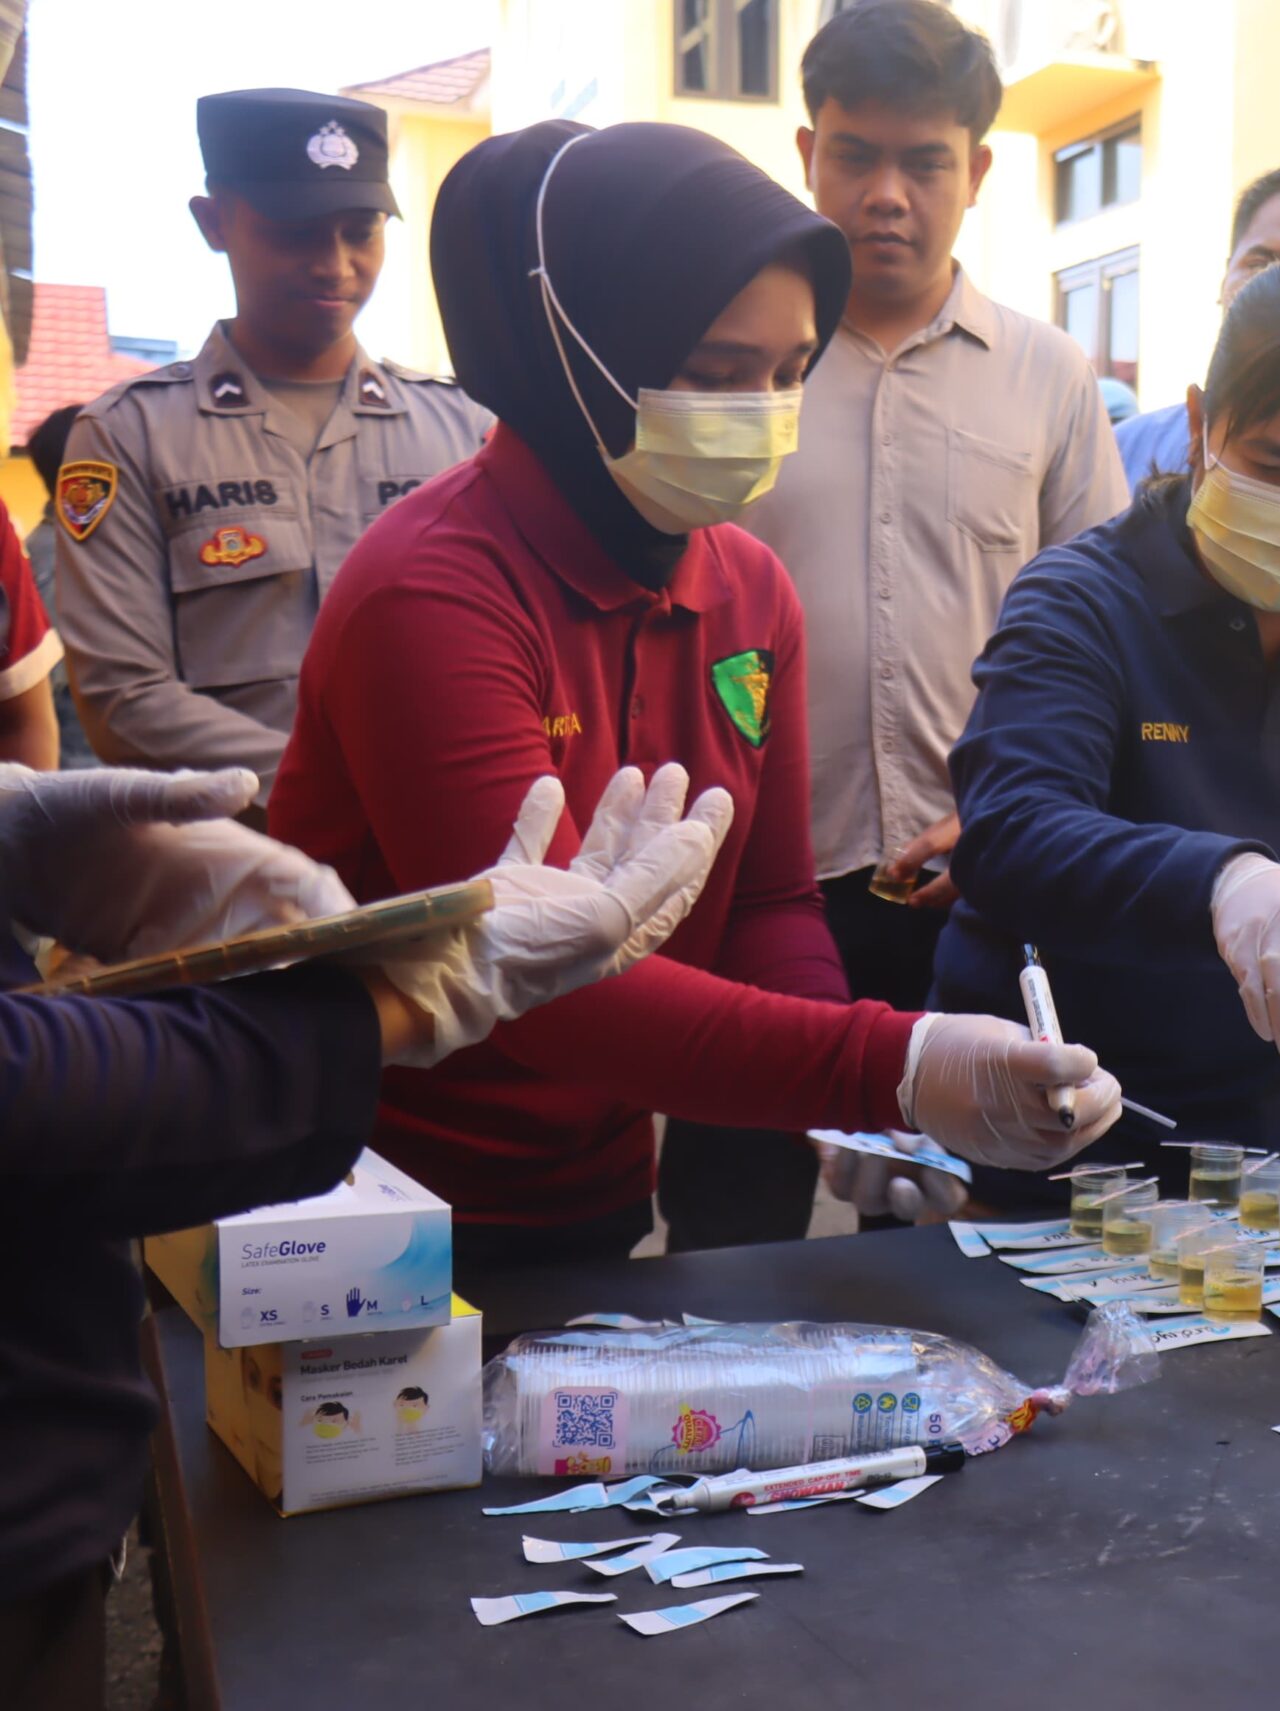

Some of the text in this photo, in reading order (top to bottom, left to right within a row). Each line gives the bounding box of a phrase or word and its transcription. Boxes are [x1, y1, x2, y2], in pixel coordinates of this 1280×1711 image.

[164, 480, 278, 518] HARIS
[1141, 722, 1189, 743] RENNY
[241, 1241, 326, 1260] SafeGlove
[367, 1300, 378, 1311] M
[420, 1295, 428, 1306] L
[260, 1309, 278, 1322] XS
[320, 1304, 330, 1316] S
[301, 1362, 341, 1375] Masker
[343, 1359, 377, 1371] Bedah
[928, 1413, 942, 1434] 50
[764, 1478, 805, 1492] EXTENDED
[845, 1469, 862, 1478] TIME
